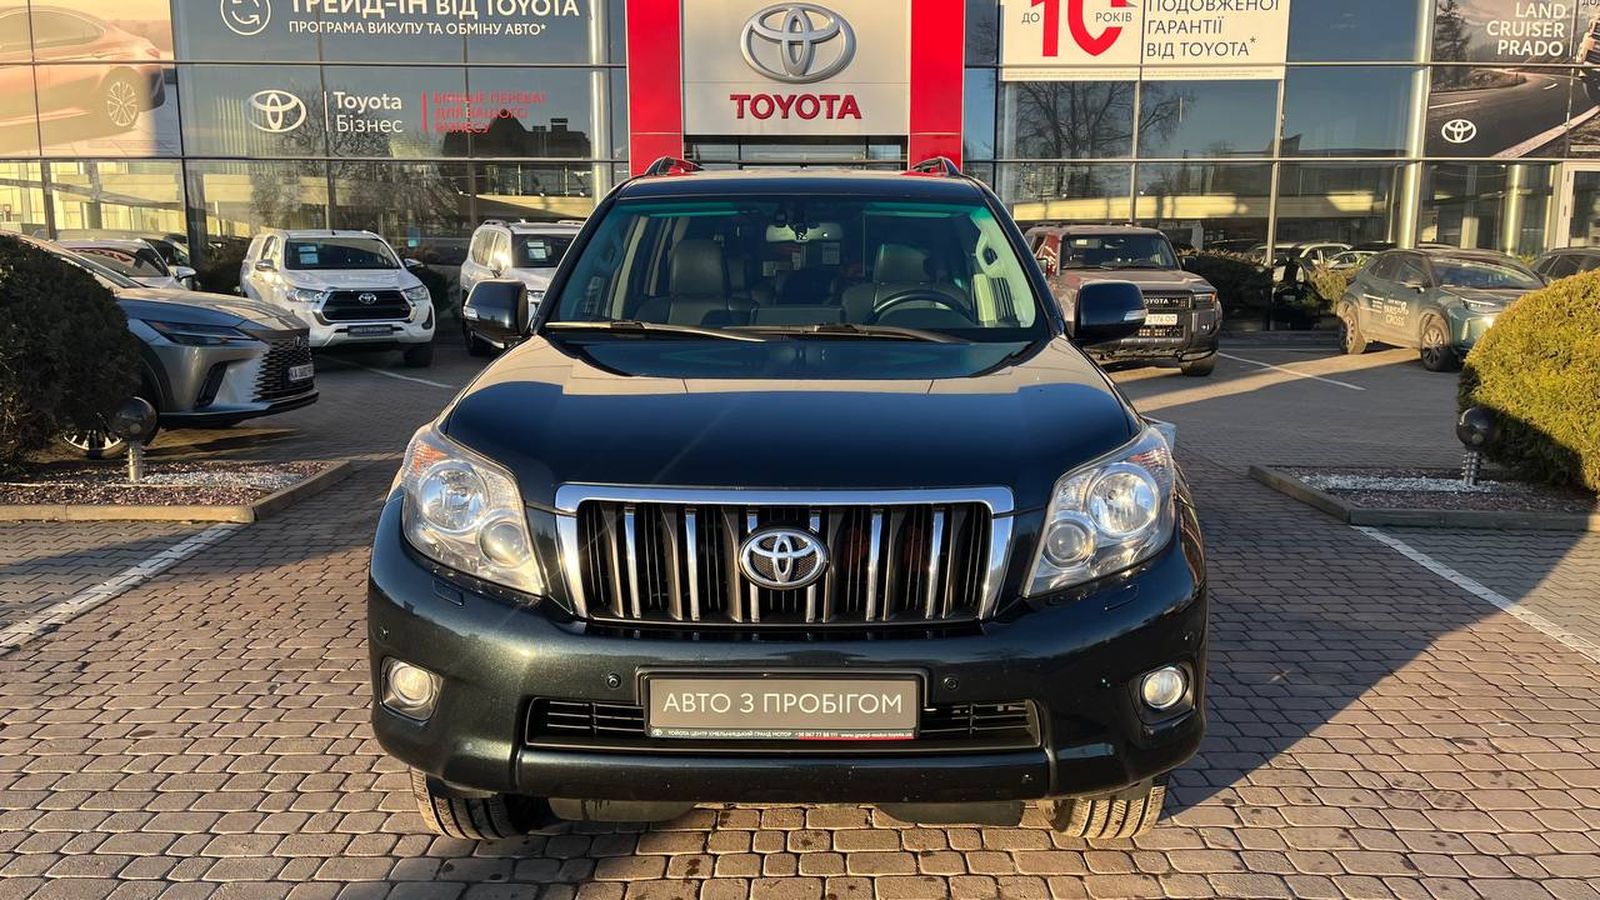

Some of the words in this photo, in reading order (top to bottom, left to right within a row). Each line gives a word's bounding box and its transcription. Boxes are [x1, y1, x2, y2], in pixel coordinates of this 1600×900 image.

[436, 0, 479, 20] ВІД
[485, 0, 580, 16] TOYOTA
[1021, 12, 1041, 24] ДО
[1096, 12, 1133, 22] РОКІВ
[1515, 3, 1567, 19] LAND
[289, 21, 365, 33] ПРОГРАМА
[368, 22, 423, 34] ВИКУПУ
[426, 23, 444, 34] ТА
[446, 22, 502, 35] ОБМІНУ
[1147, 15, 1224, 34] ГАРАНТІЇ
[1486, 20, 1565, 38] CRUISER
[1146, 42, 1175, 59] ВІД
[1497, 39, 1564, 57] PRADO
[333, 91, 402, 114] Toyota
[730, 93, 862, 120] TOYOTA
[336, 114, 403, 133] Бізнес
[663, 692, 731, 714] АВТО
[739, 693, 754, 714] З
[763, 692, 903, 714] ПРОБІГОМ
